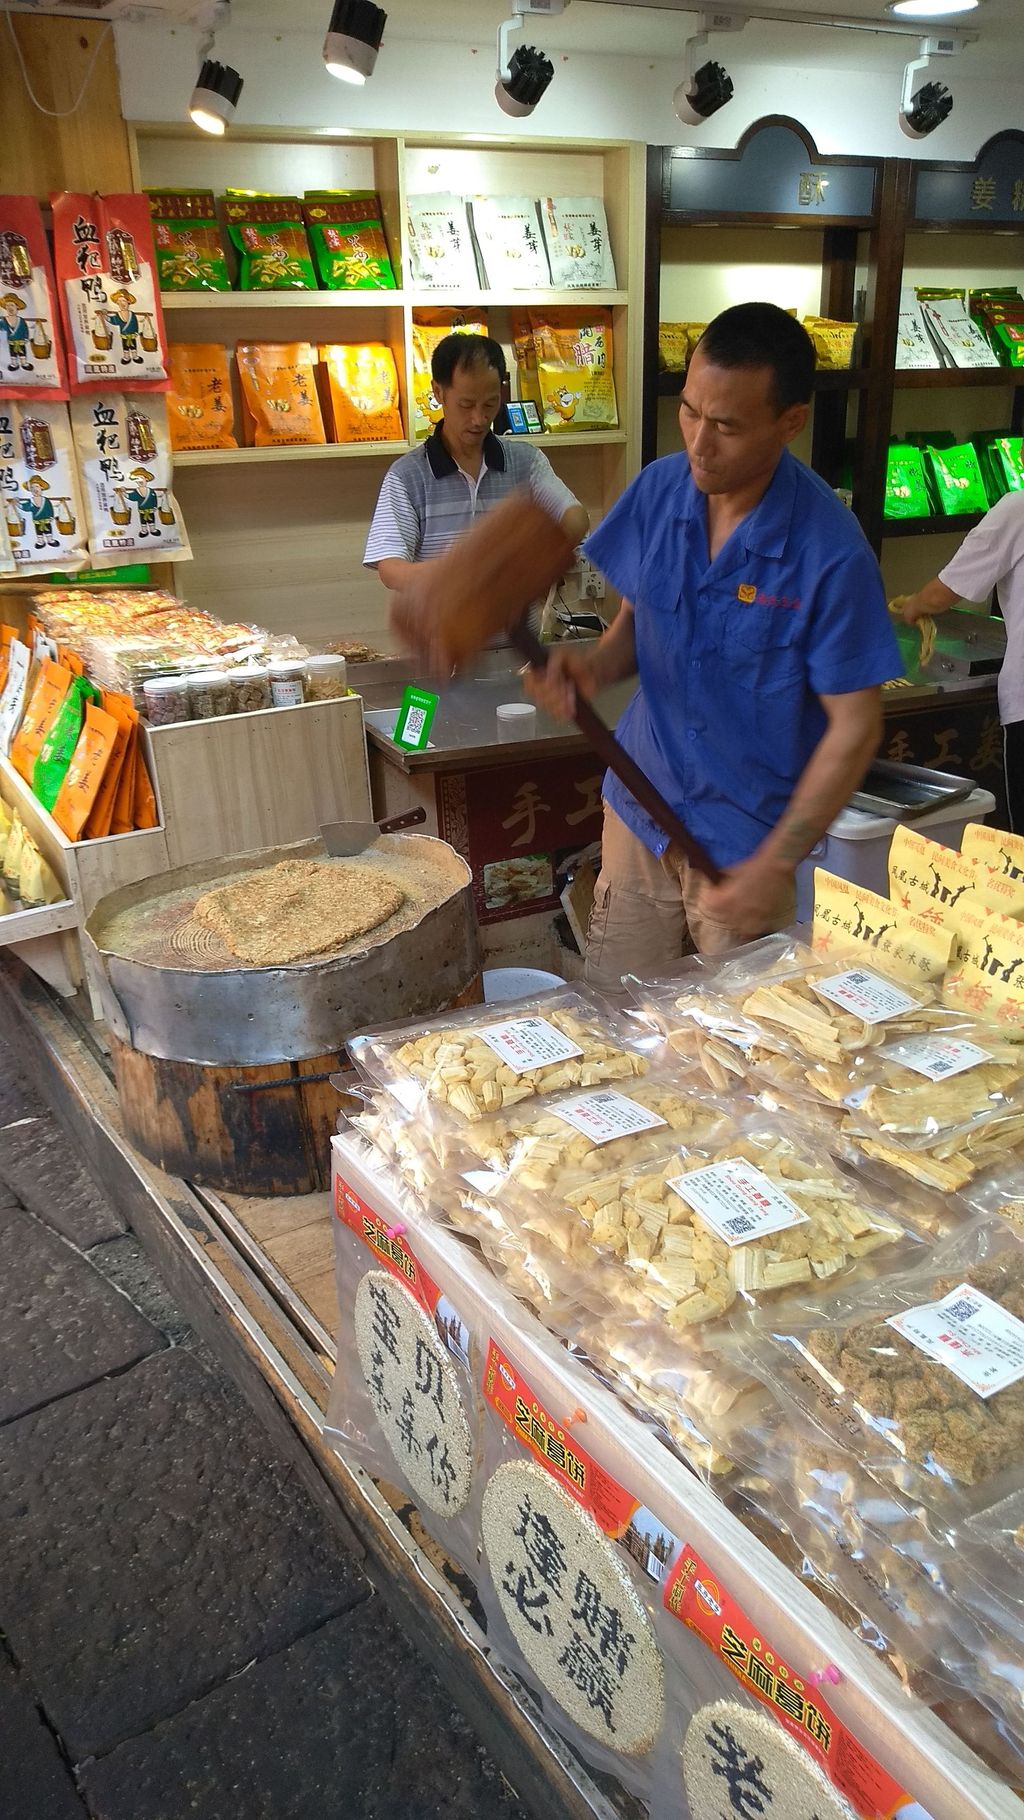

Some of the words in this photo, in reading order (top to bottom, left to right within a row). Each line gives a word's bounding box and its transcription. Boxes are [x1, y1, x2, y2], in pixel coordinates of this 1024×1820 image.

[93, 402, 124, 482] 血粑鸭
[515, 1395, 586, 1488] 芝麻葛饼
[720, 1624, 832, 1752] 芝麻葛饼
